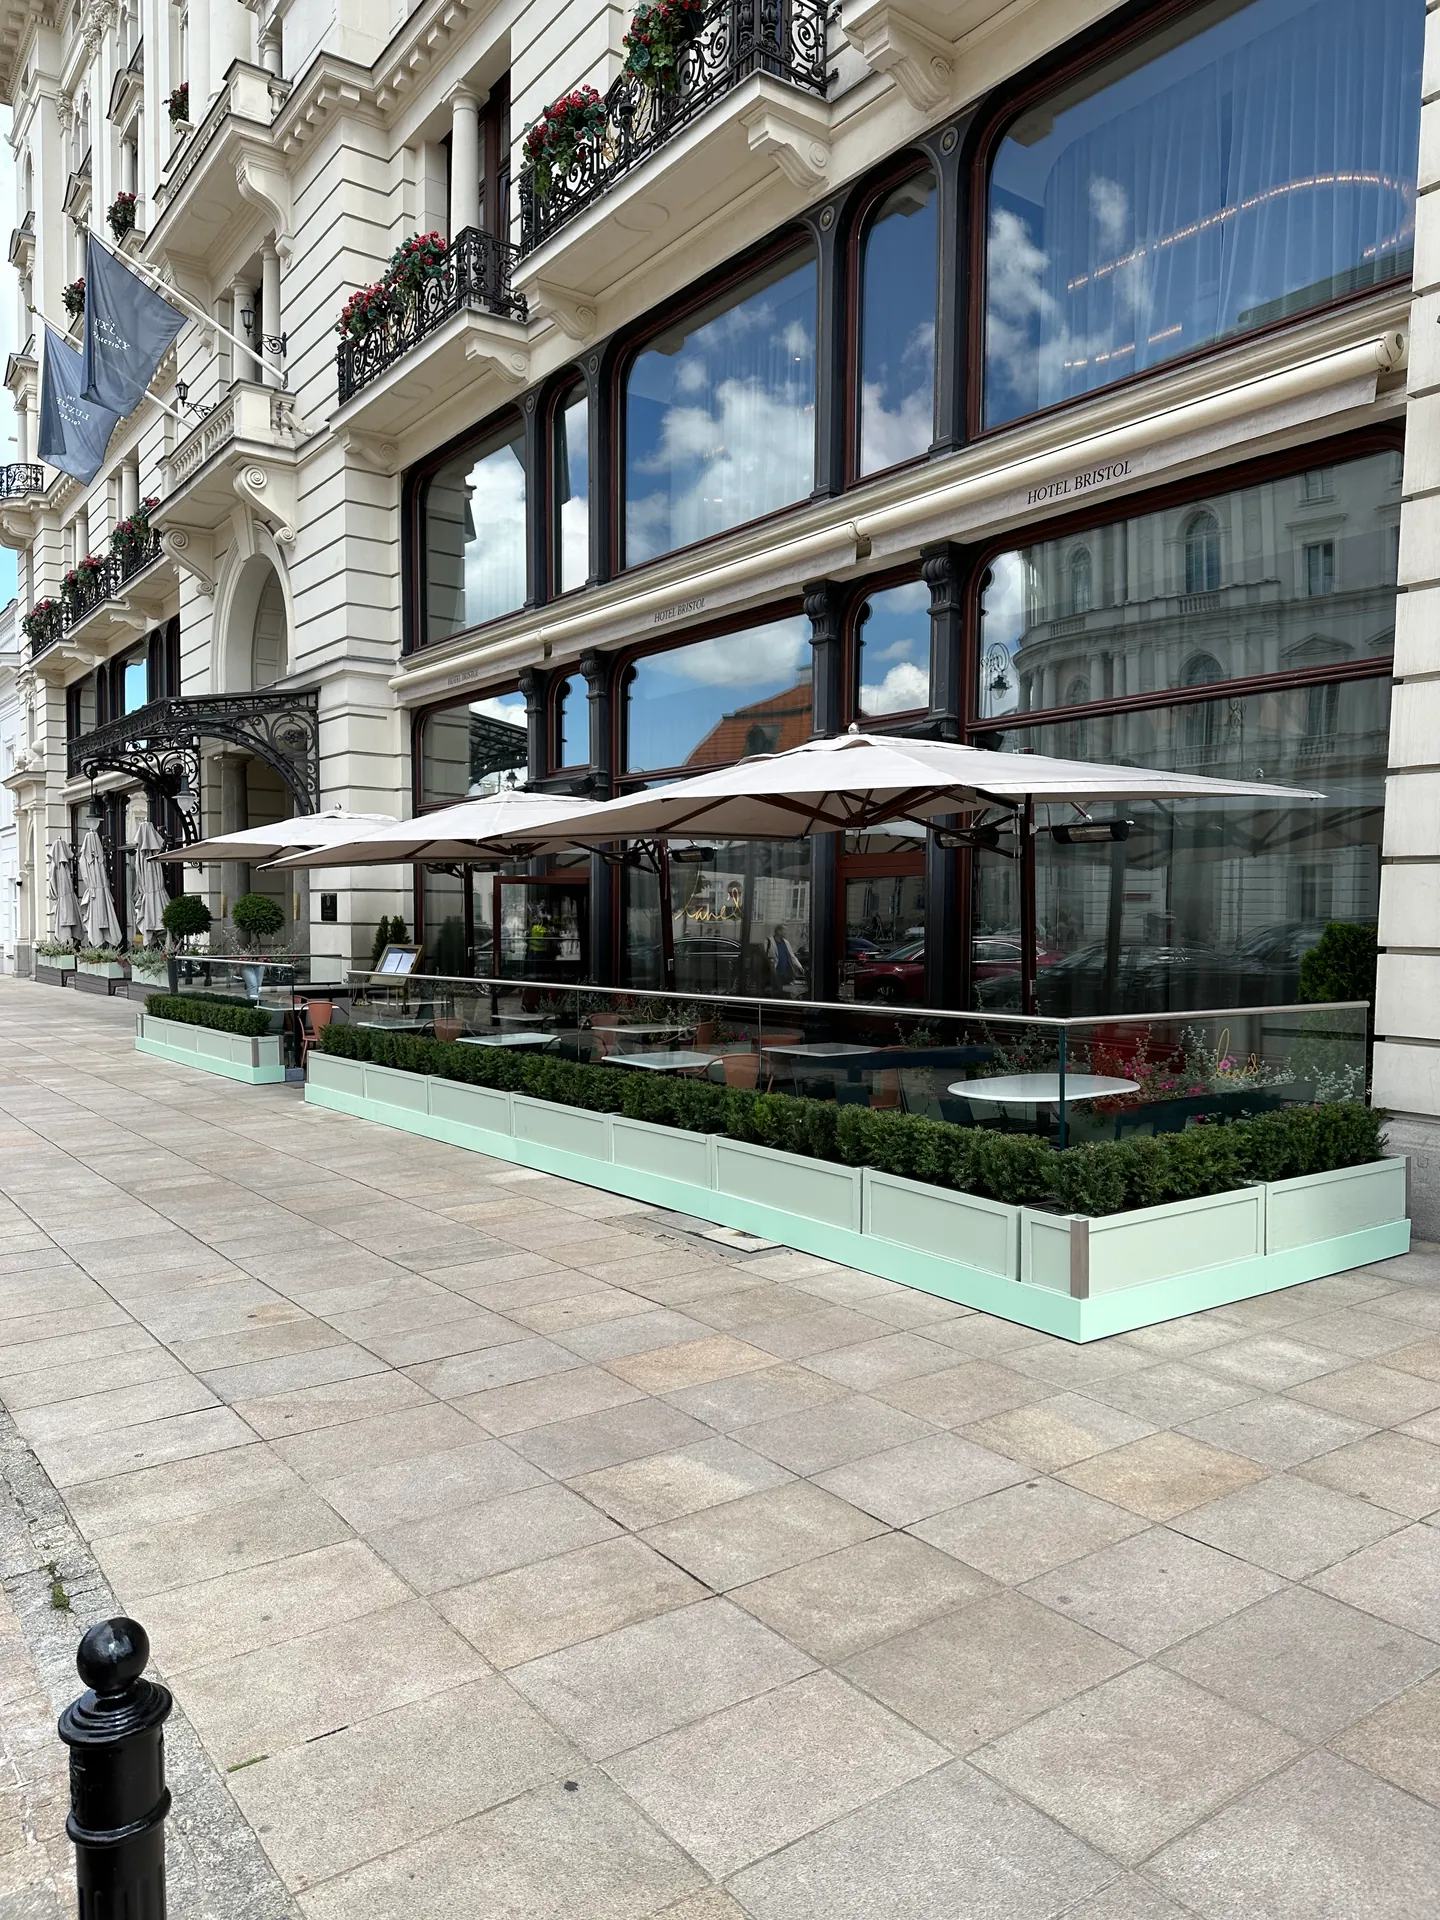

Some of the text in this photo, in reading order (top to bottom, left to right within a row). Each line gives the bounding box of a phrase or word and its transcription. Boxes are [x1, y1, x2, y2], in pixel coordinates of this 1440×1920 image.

[1027, 460, 1132, 504] HOTEL BRISTOL
[654, 597, 706, 623] HOTEL BRISTOL
